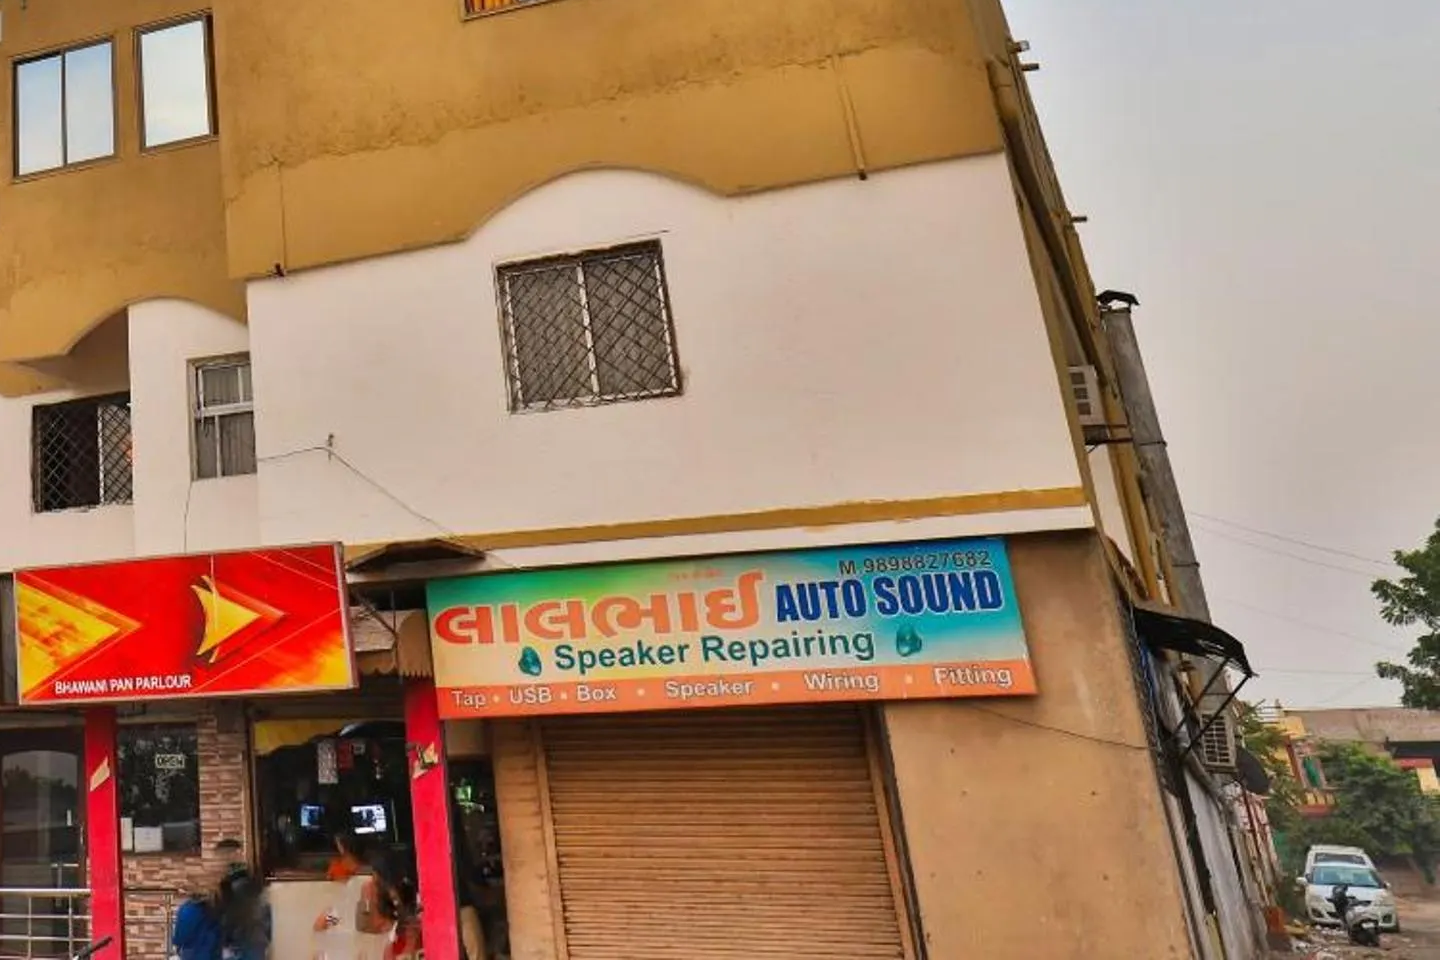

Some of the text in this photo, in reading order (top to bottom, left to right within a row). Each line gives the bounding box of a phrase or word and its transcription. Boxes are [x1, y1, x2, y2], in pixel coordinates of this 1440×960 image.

[775, 577, 866, 624] AUTO
[873, 569, 1005, 617] SOUND
[554, 628, 875, 672] Speaker Repairing
[54, 673, 193, 696] BHAWANI PAN PARLOUR
[452, 665, 1014, 709] Tap USB Box Speaker Wiring Fitting
[157, 755, 184, 768] OPEN
